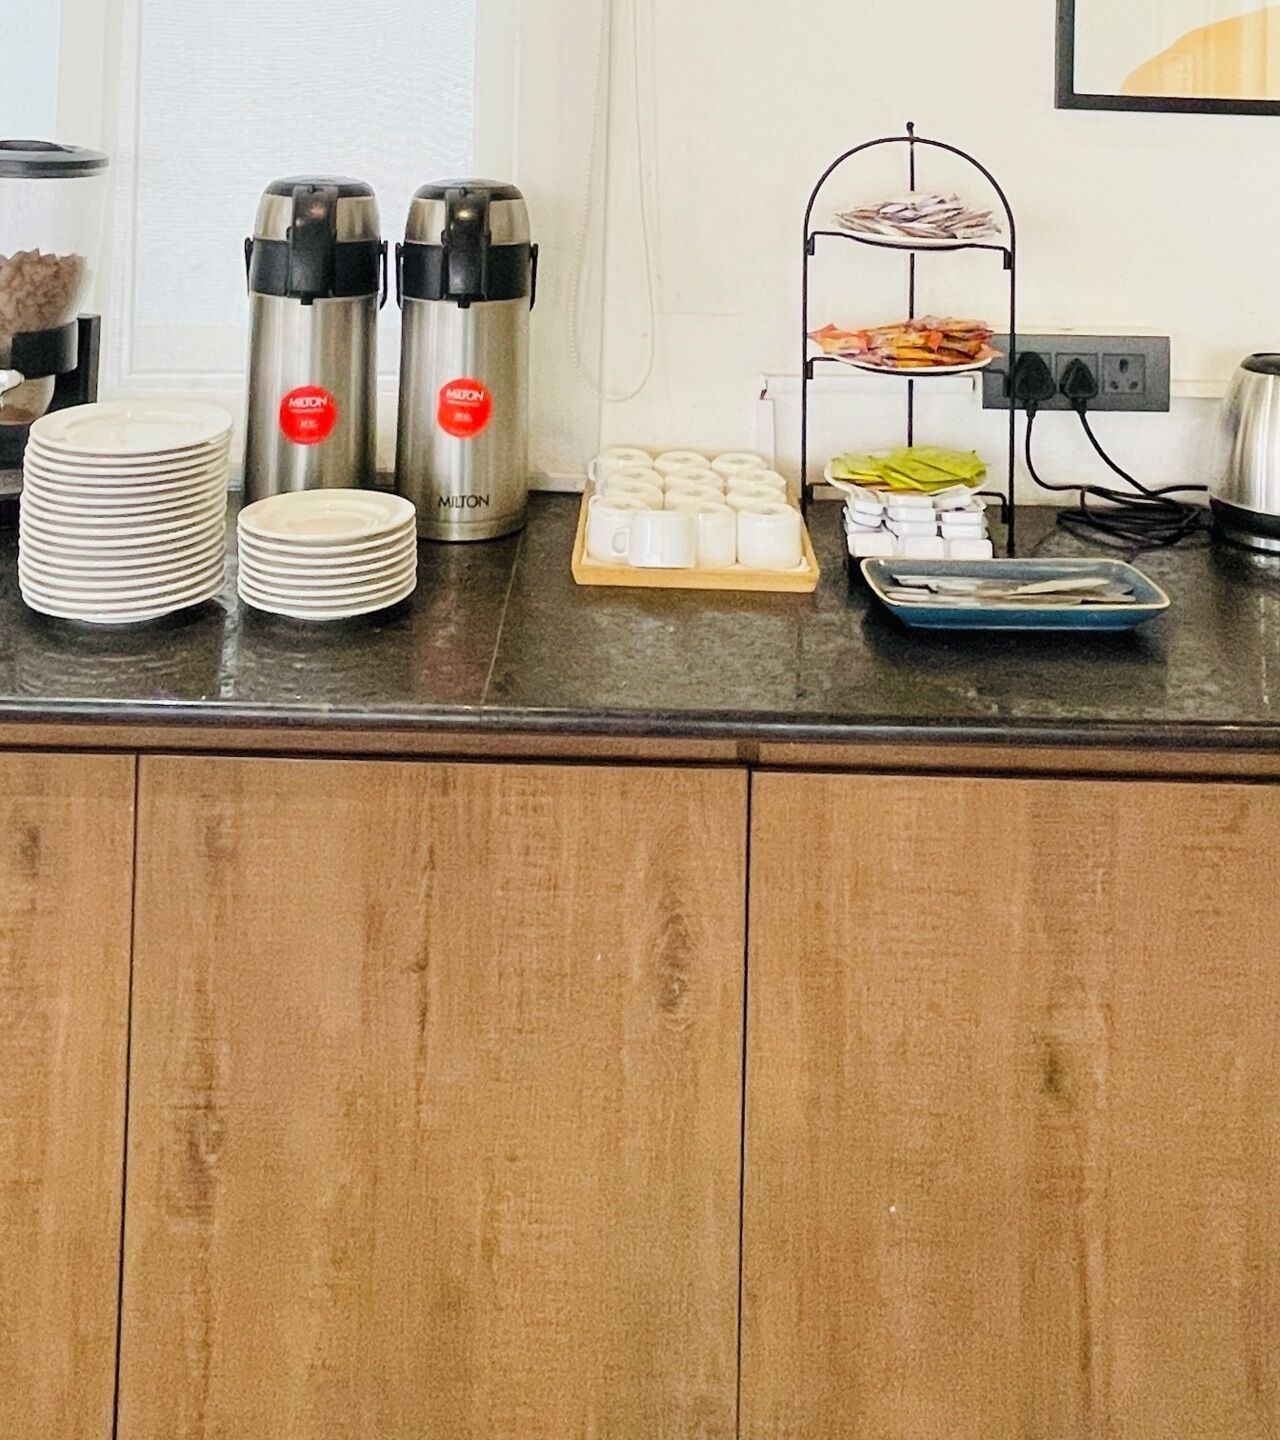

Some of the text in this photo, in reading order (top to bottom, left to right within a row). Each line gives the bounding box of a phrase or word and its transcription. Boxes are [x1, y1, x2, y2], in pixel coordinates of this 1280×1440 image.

[288, 395, 328, 408] MILTON
[445, 389, 484, 401] MILTON
[438, 494, 490, 509] MILTON
